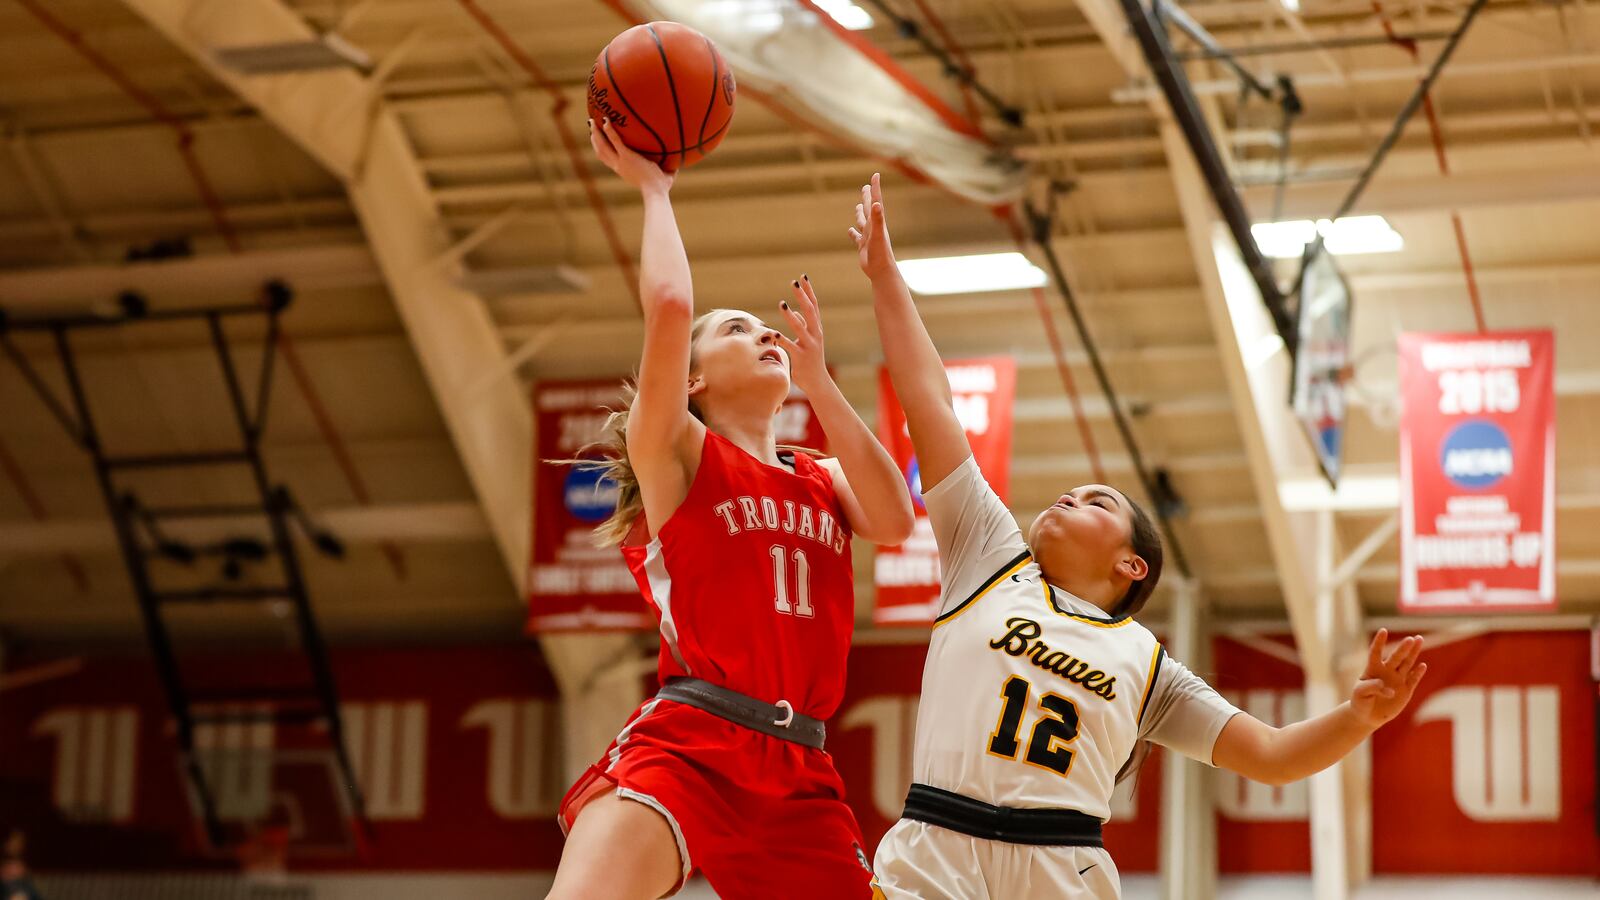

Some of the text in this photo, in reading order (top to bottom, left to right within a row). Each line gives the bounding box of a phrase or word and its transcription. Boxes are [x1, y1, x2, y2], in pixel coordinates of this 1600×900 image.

[1438, 369, 1520, 414] 2015
[713, 495, 846, 555] TROJANS
[769, 543, 815, 619] 11
[989, 616, 1117, 702] Braves
[986, 673, 1081, 779] 12
